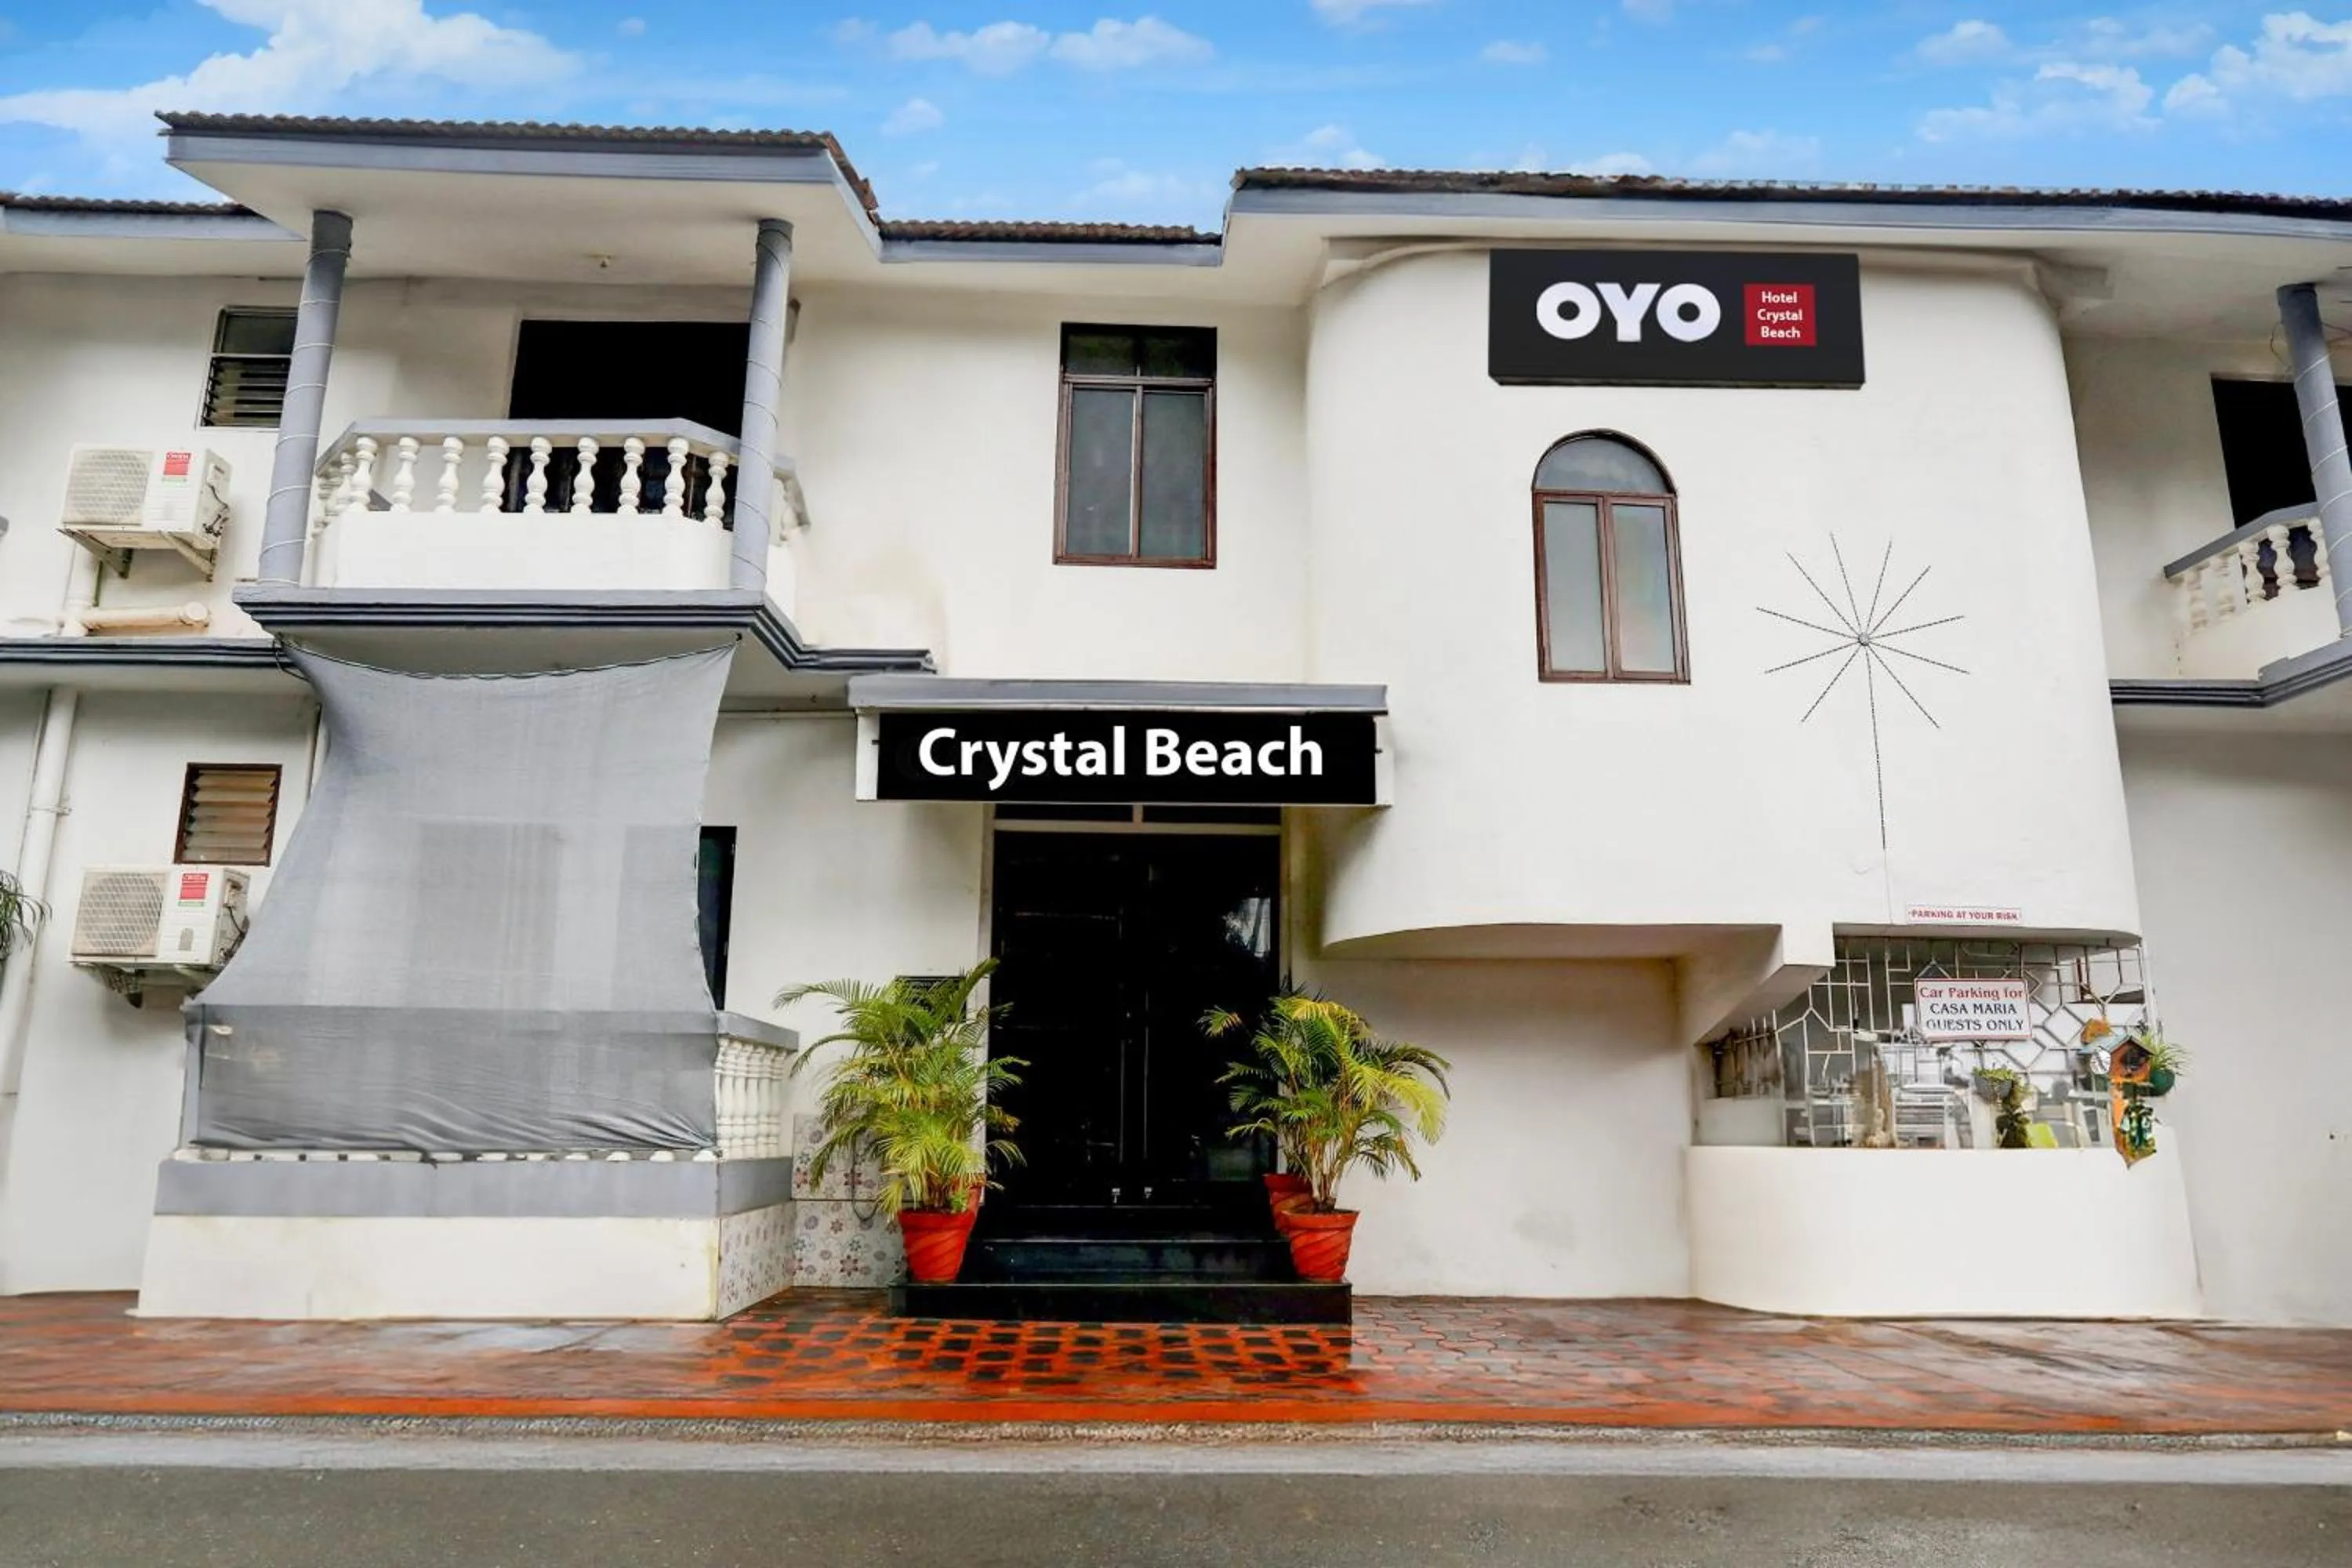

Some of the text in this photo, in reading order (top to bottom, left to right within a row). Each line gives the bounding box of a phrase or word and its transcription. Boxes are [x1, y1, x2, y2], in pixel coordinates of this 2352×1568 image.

[1762, 291, 1798, 303] Hotel
[1536, 281, 1721, 343] OYO
[1757, 308, 1803, 324] Crystal
[1760, 325, 1801, 339] Beach
[918, 725, 1323, 791] Crystal Beach
[1911, 909, 2019, 920] PARKING AT YOUR RISK
[1920, 987, 2024, 1000] Car Parking for
[1929, 1003, 2017, 1014] CASA MARIA
[1926, 1019, 2024, 1031] GUESTS ONLY
